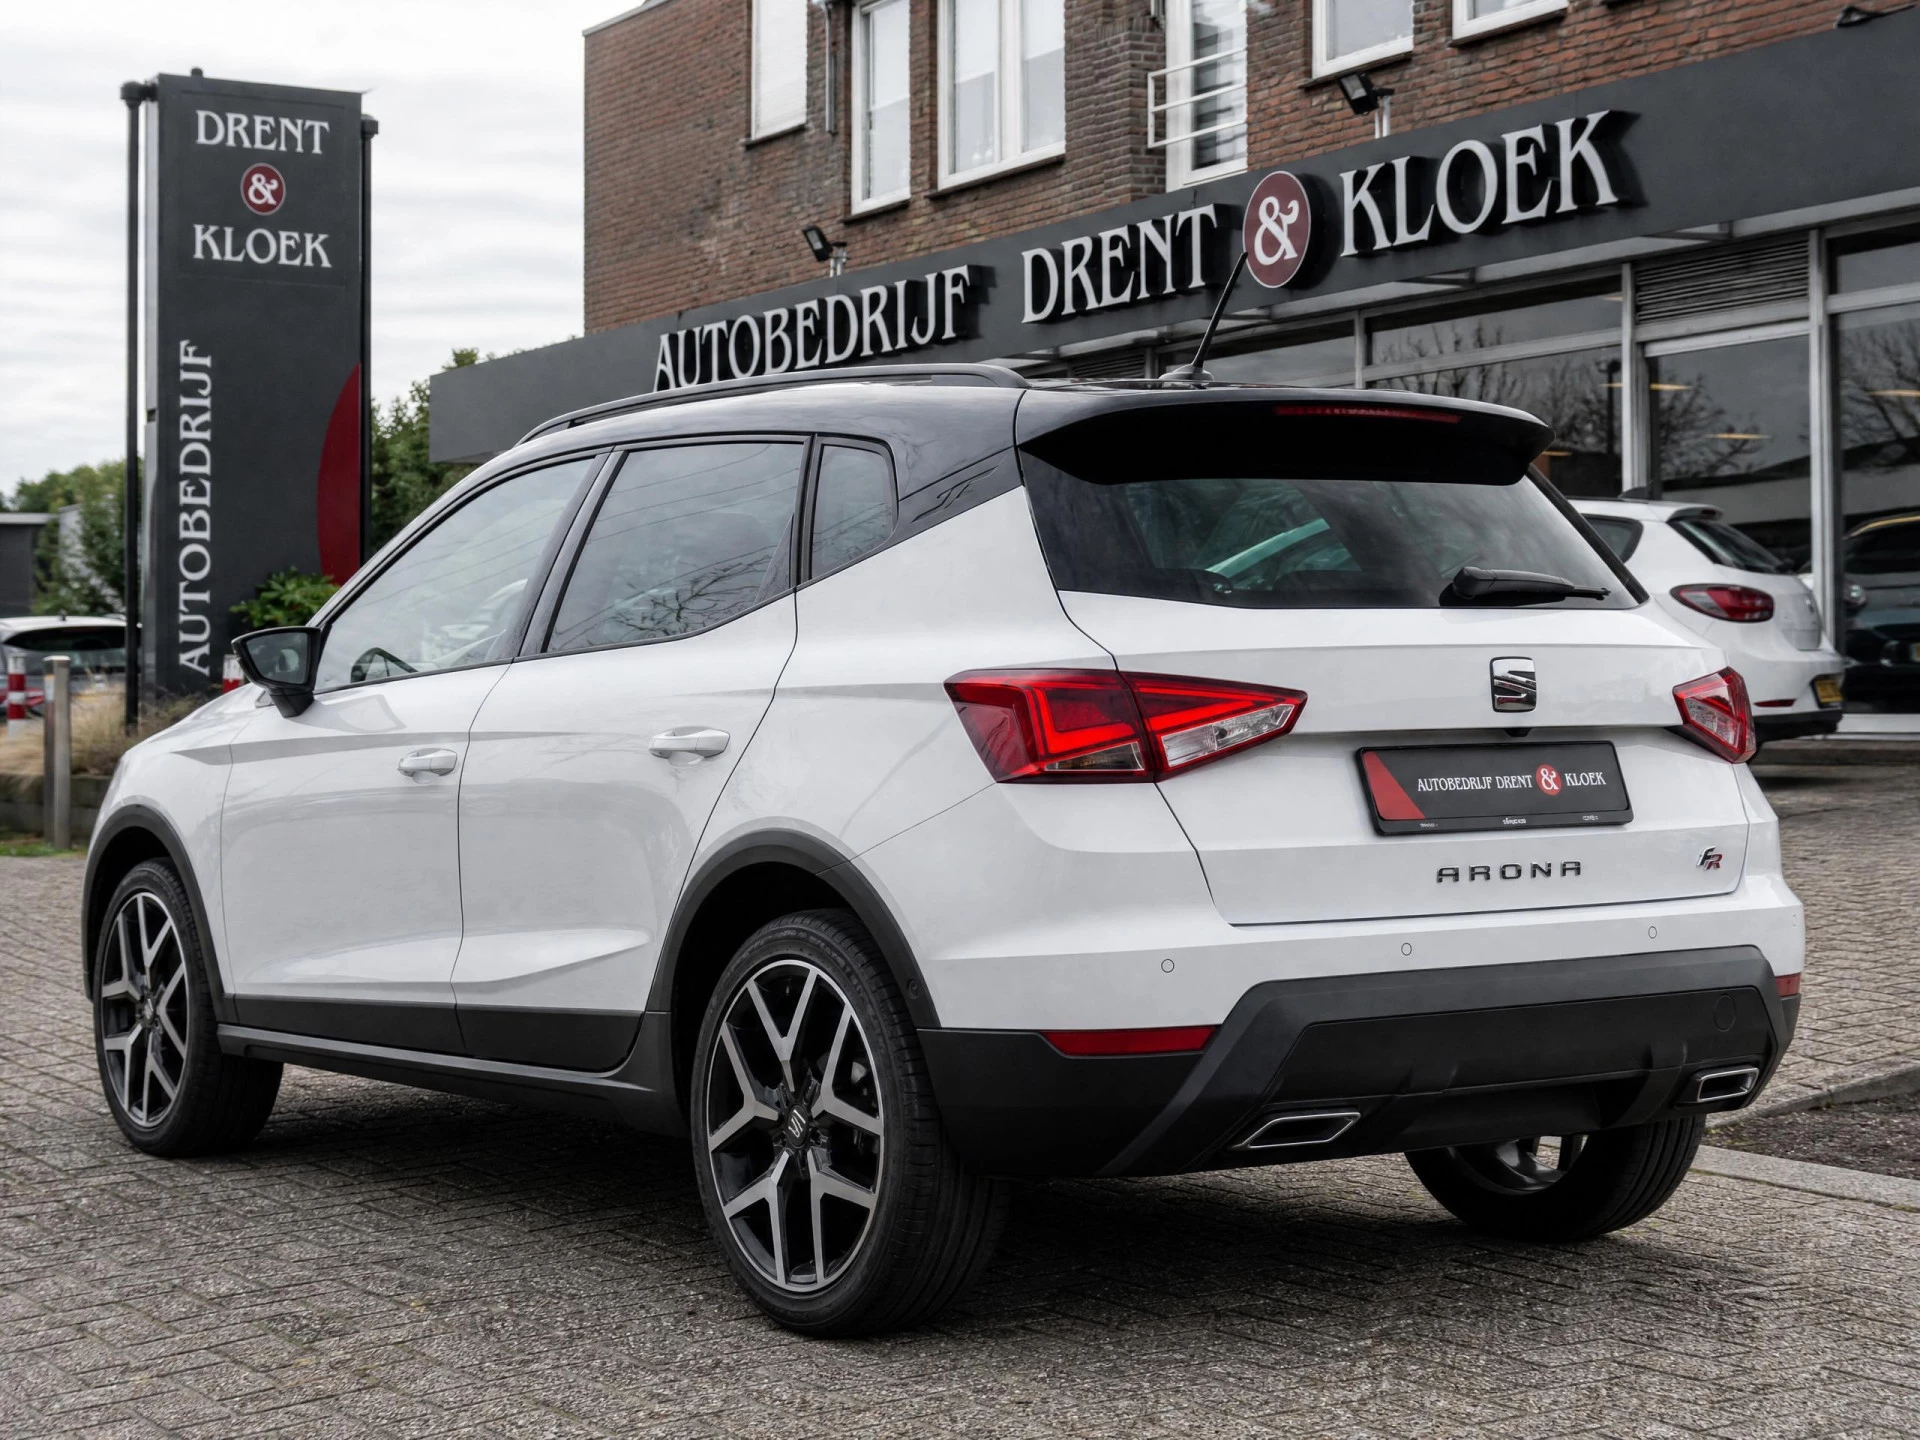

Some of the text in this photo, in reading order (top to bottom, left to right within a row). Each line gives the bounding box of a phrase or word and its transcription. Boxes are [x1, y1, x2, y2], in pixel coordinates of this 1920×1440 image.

[195, 109, 330, 155] DRENT
[247, 172, 279, 205] &
[193, 224, 332, 268] KLOEK
[653, 109, 1619, 393] AUTOBEDRIJF DRENT & KLOEK
[179, 339, 212, 677] AUTOBEDRIJF
[1417, 767, 1607, 792] AUTOBEDRIJF DRENT & KLOEK
[1436, 860, 1582, 883] ARONA
